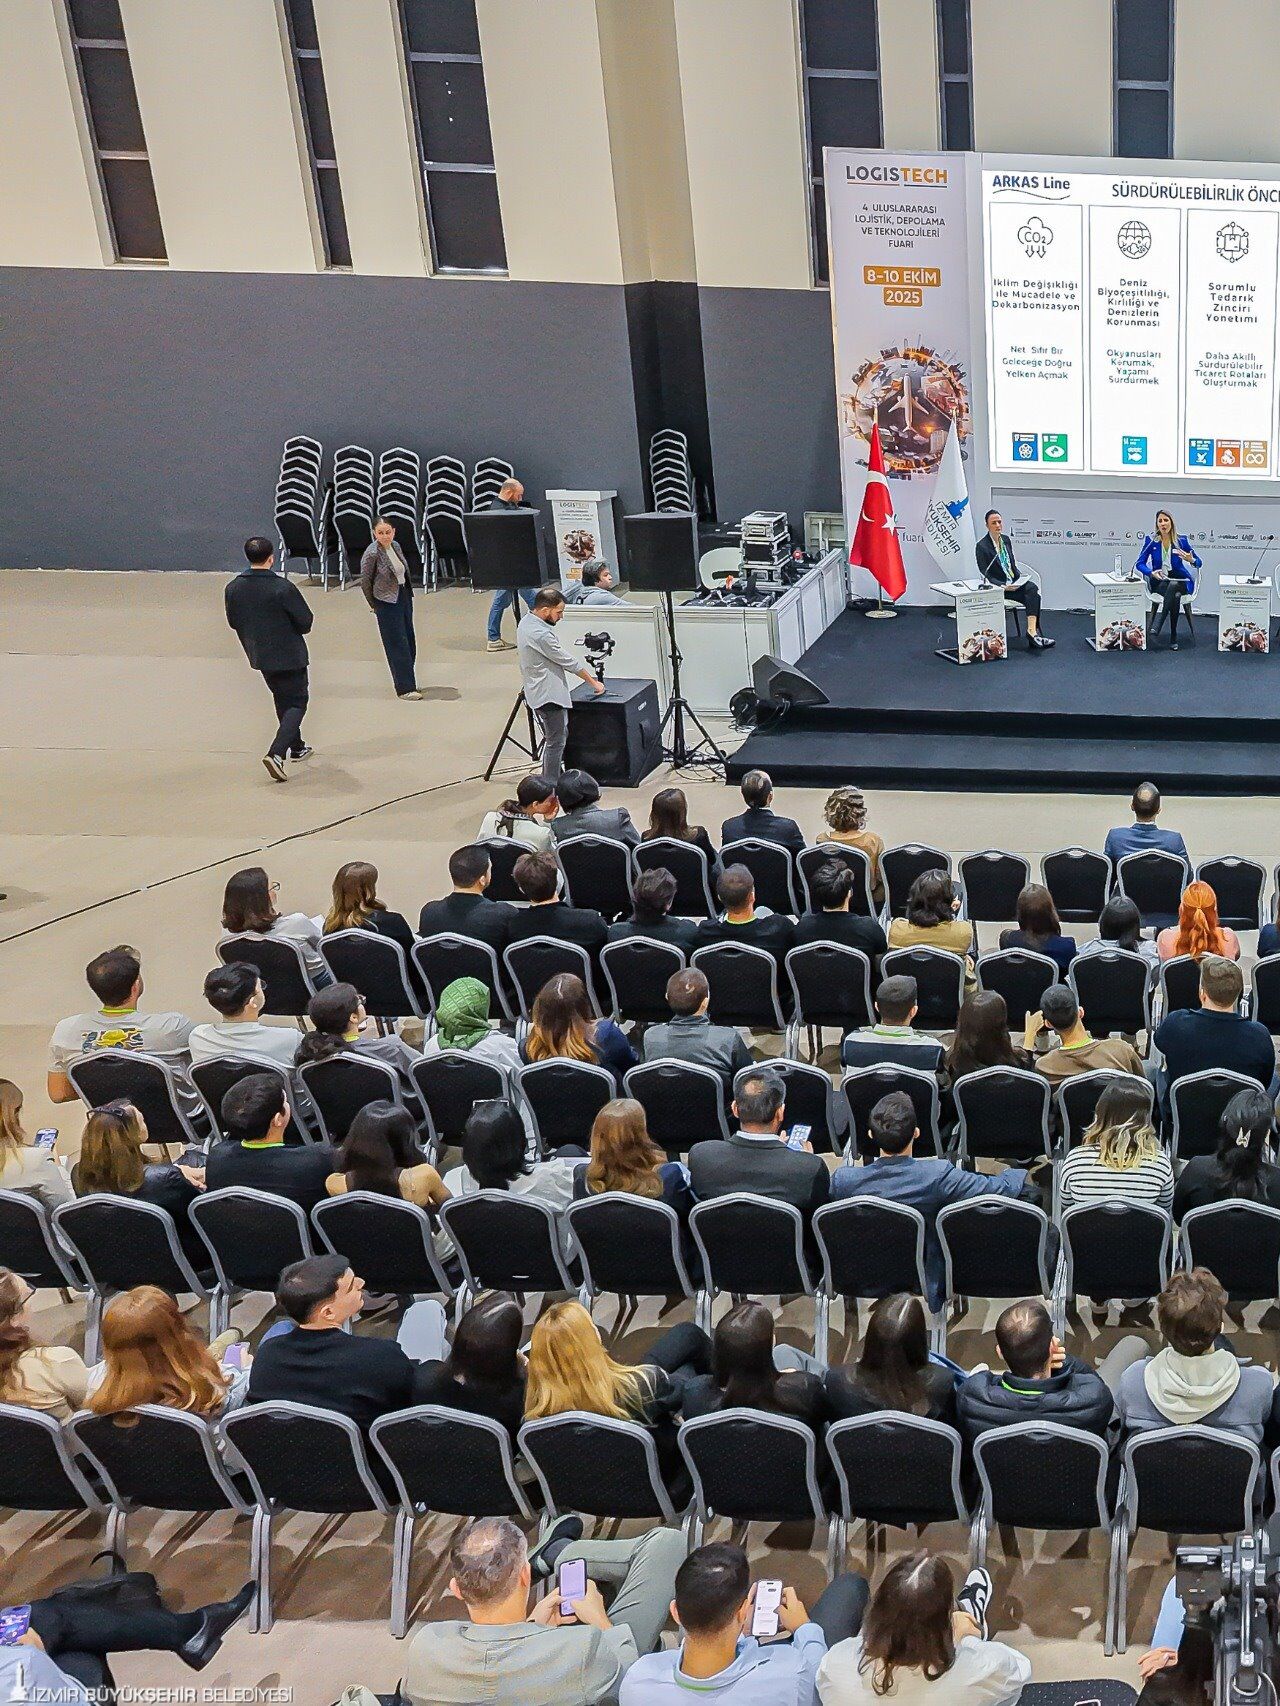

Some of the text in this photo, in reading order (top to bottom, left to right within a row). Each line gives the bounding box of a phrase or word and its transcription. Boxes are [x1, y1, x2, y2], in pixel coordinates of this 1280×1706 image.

[846, 165, 948, 184] LOGISTECH
[992, 175, 1071, 190] ARKAS Line
[1112, 180, 1245, 202] SÜRDÜRÜLEBİLİRLİK
[872, 203, 937, 214] ULUSLARARASI
[896, 216, 946, 226] DEPOLAMA
[861, 226, 873, 235] VE
[888, 239, 914, 249] FUARI
[867, 268, 937, 284] 8-10 EKİM
[1119, 278, 1148, 287] Deniz
[1208, 282, 1256, 292] Sorumlu
[886, 290, 920, 304] 2025
[992, 300, 1080, 312] Dekarbonizasyon
